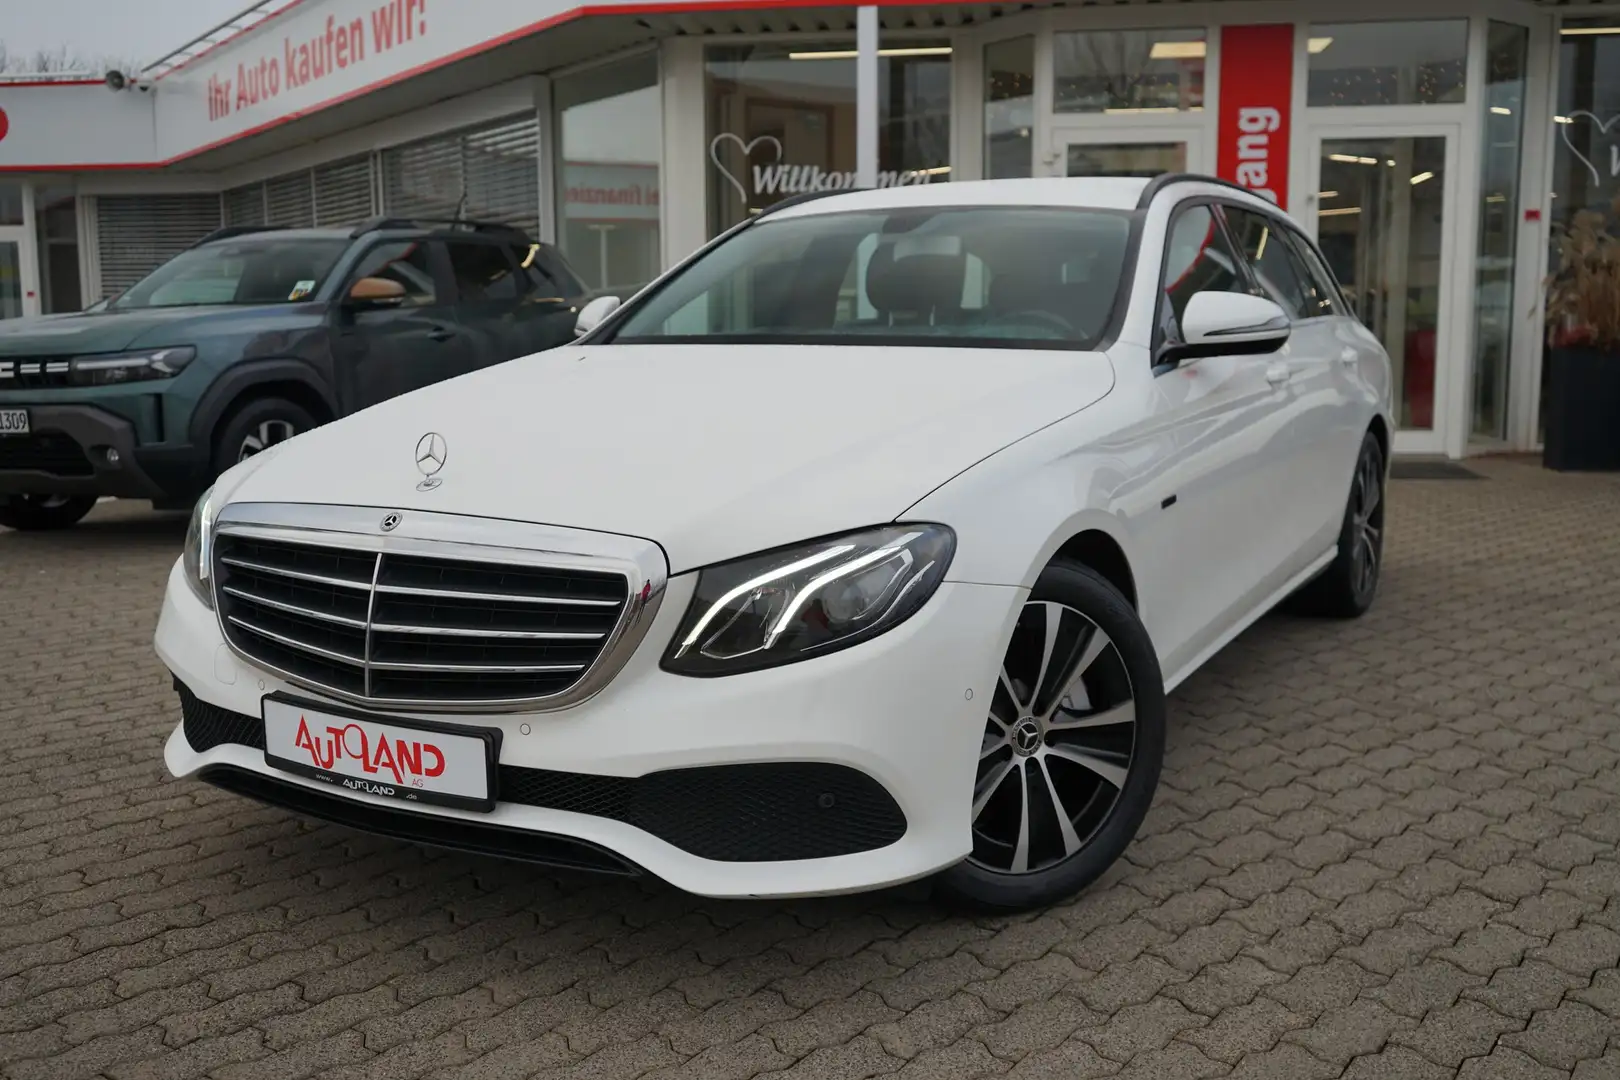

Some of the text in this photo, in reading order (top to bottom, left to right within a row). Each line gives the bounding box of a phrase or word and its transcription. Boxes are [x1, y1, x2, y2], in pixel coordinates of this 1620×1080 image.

[208, 0, 426, 122] Ihr Auto kaufen wir!
[411, 778, 424, 788] AG
